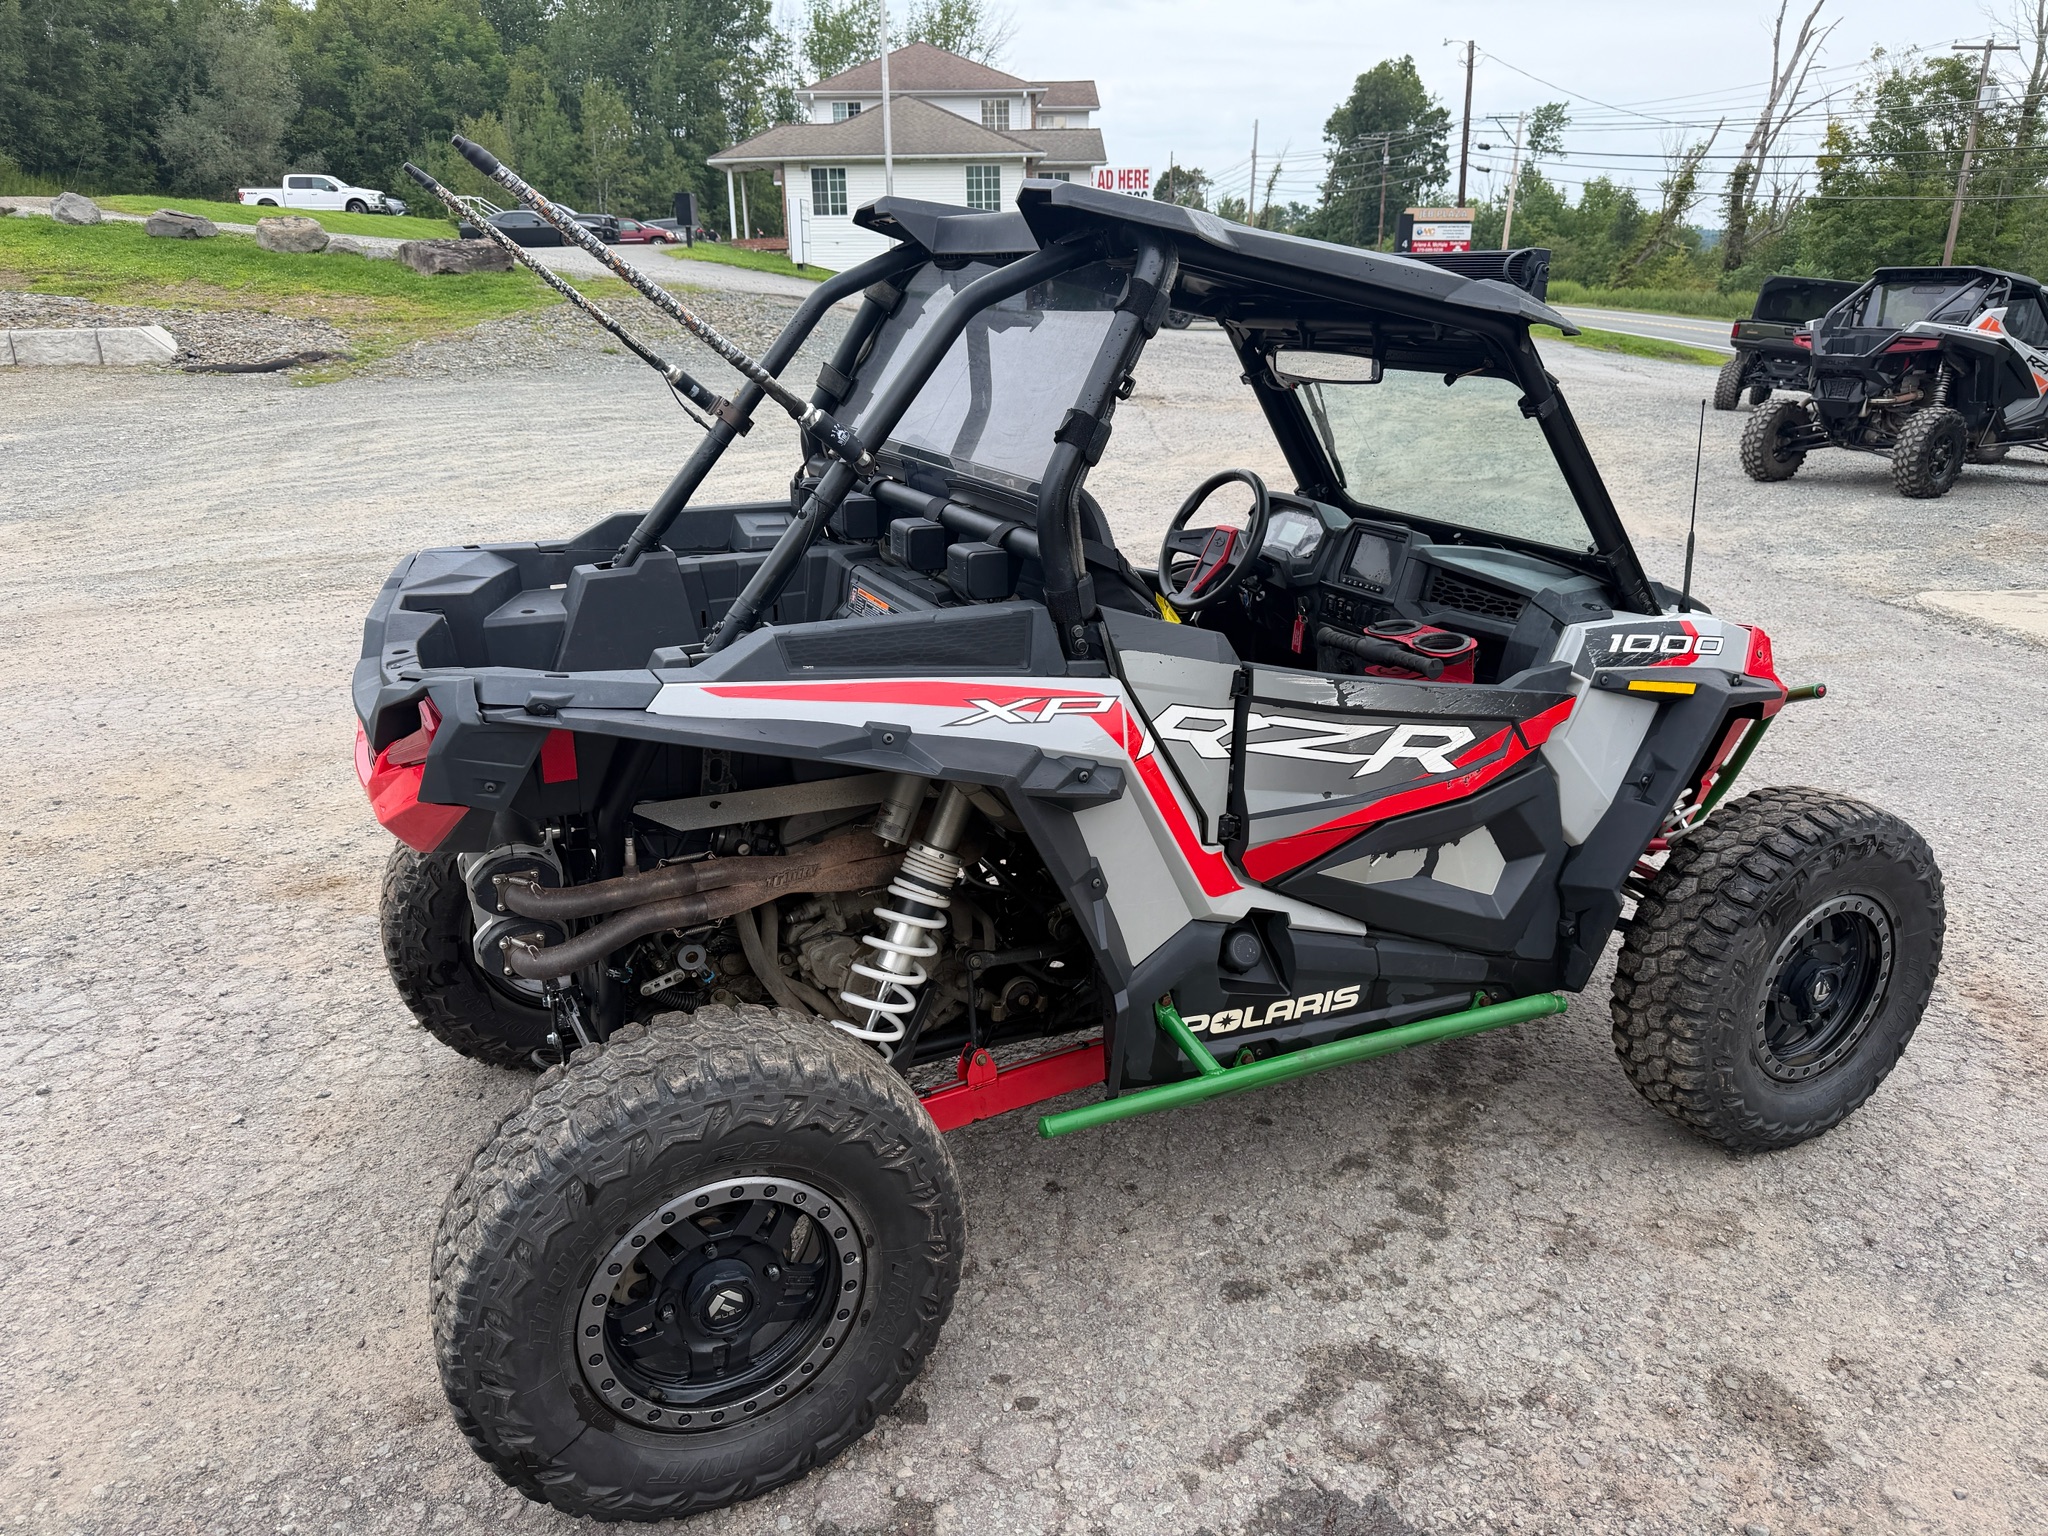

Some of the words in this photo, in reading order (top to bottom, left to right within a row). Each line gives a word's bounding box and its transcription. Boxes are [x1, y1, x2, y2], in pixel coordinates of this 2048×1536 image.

[1097, 169, 1114, 190] AD
[1118, 169, 1149, 190] HERE
[1437, 209, 1468, 219] PLAZA
[2026, 355, 2048, 375] RZ
[1608, 633, 1724, 656] 1000
[940, 696, 1120, 728] XP
[1135, 703, 1477, 779] RZR
[1181, 984, 1361, 1034] POLARIS
